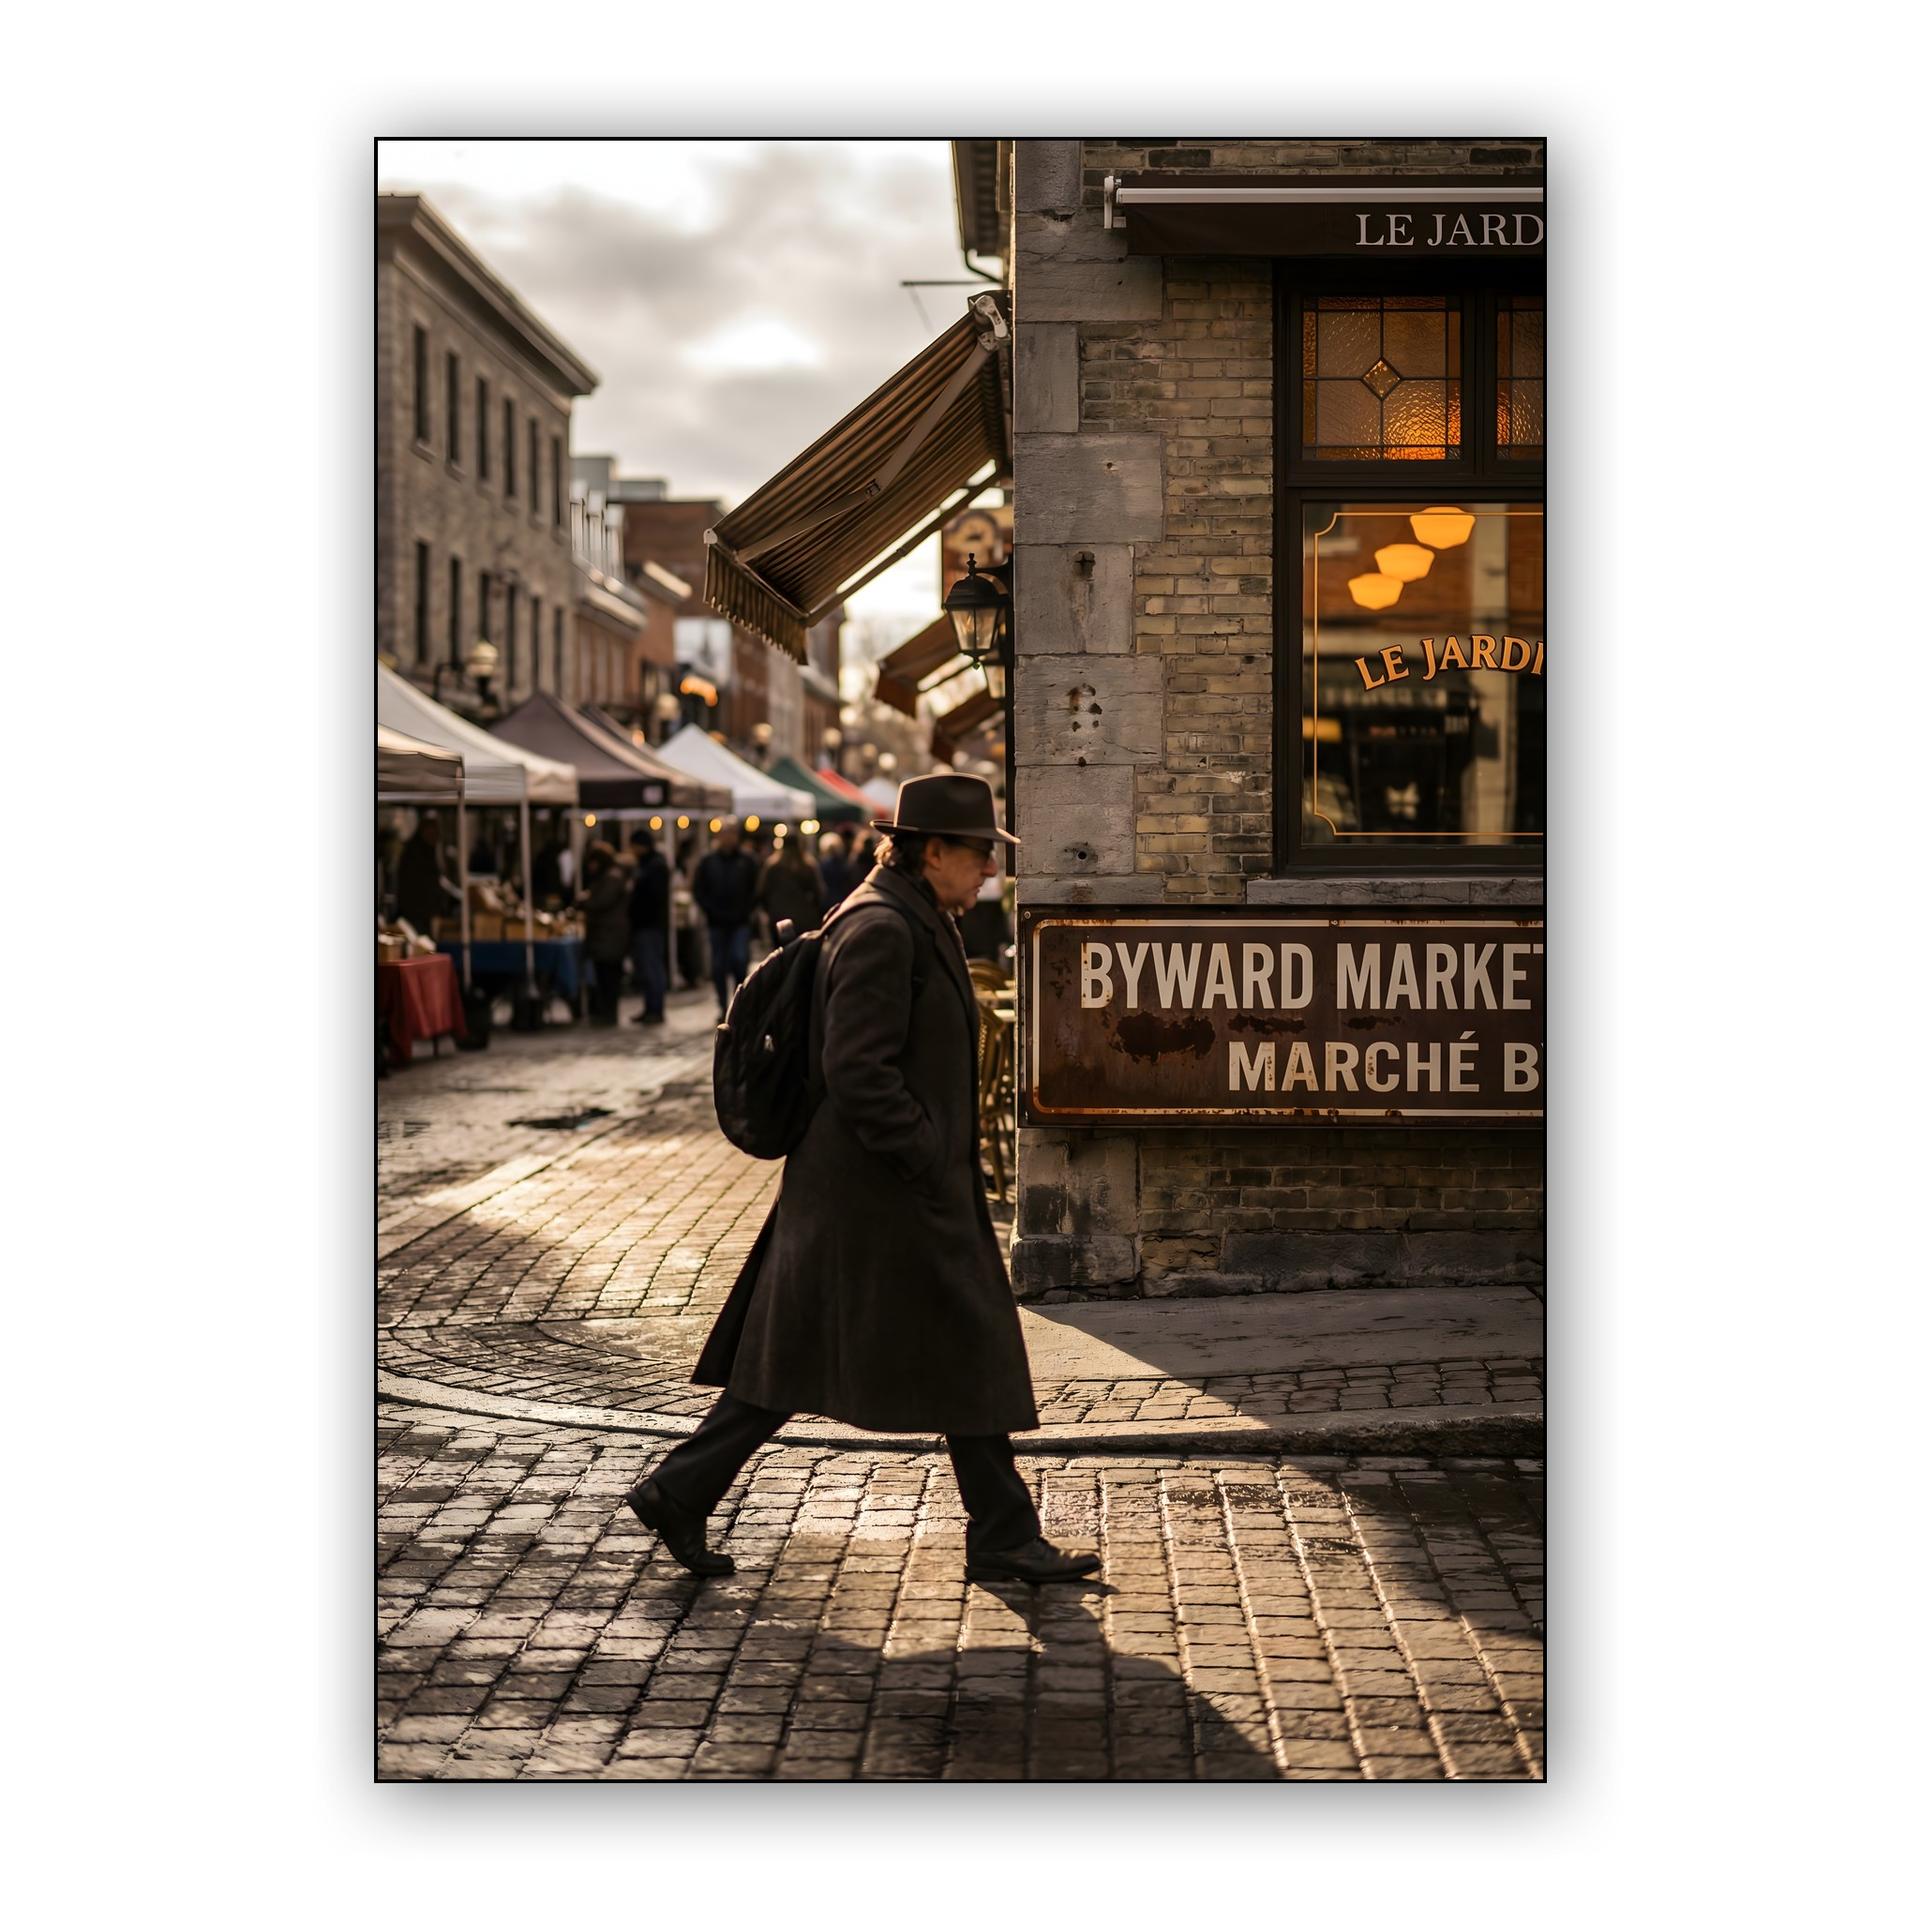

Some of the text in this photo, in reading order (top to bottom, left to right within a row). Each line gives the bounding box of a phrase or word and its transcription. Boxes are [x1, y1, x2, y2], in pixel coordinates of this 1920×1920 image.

[1355, 213, 1544, 247] LE JARD
[1354, 645, 1410, 690] LE
[1080, 942, 1315, 1009] BYWARD
[1228, 1030, 1544, 1093] MARCHÉ B
